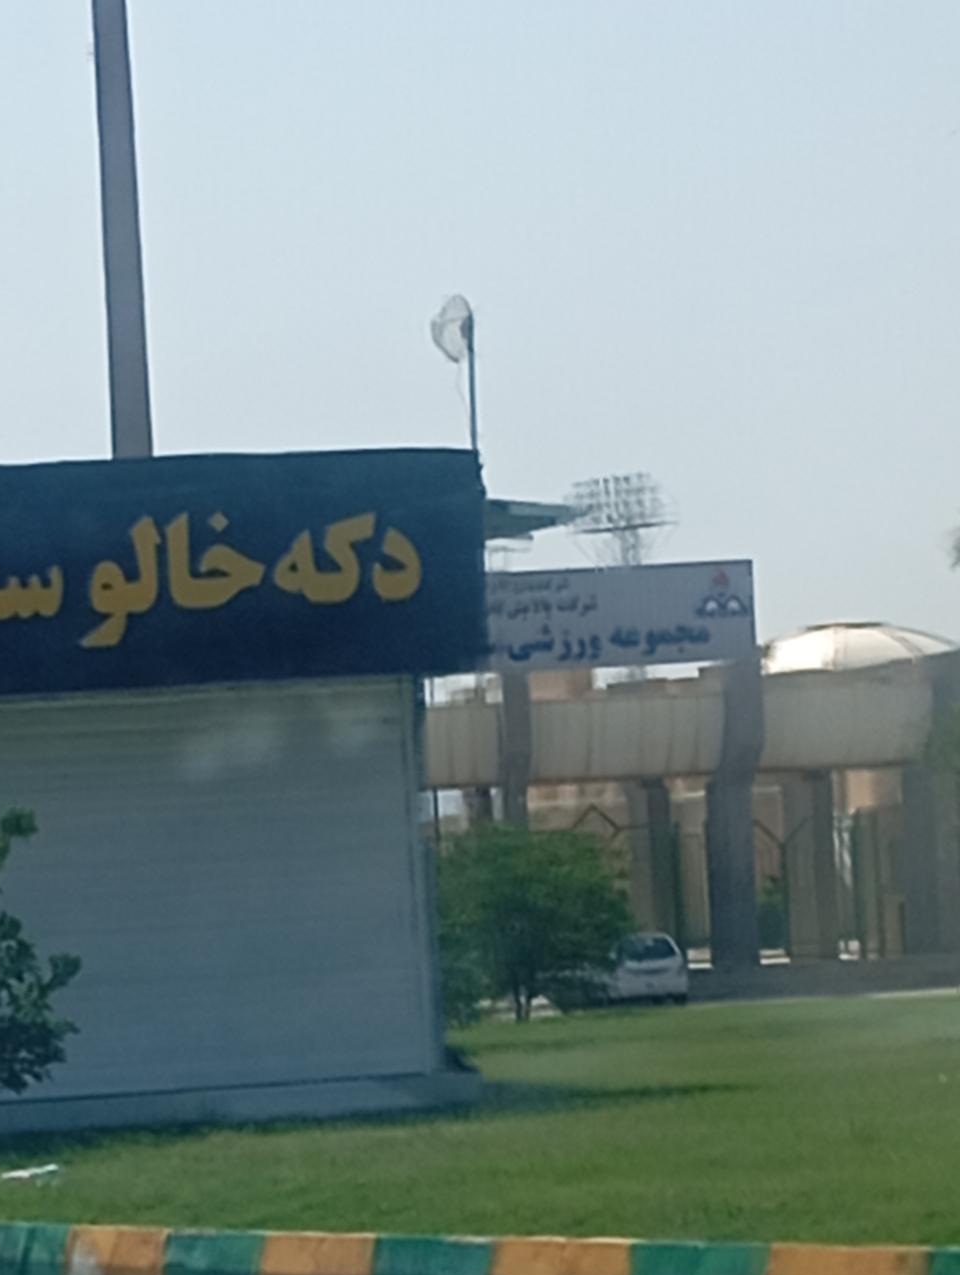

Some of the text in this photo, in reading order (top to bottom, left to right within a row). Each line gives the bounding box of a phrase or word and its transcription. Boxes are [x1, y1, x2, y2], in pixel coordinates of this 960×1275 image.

[79, 511, 266, 649] خالو
[273, 512, 422, 605] دکه
[507, 623, 711, 662] مجموعه ورزشی
